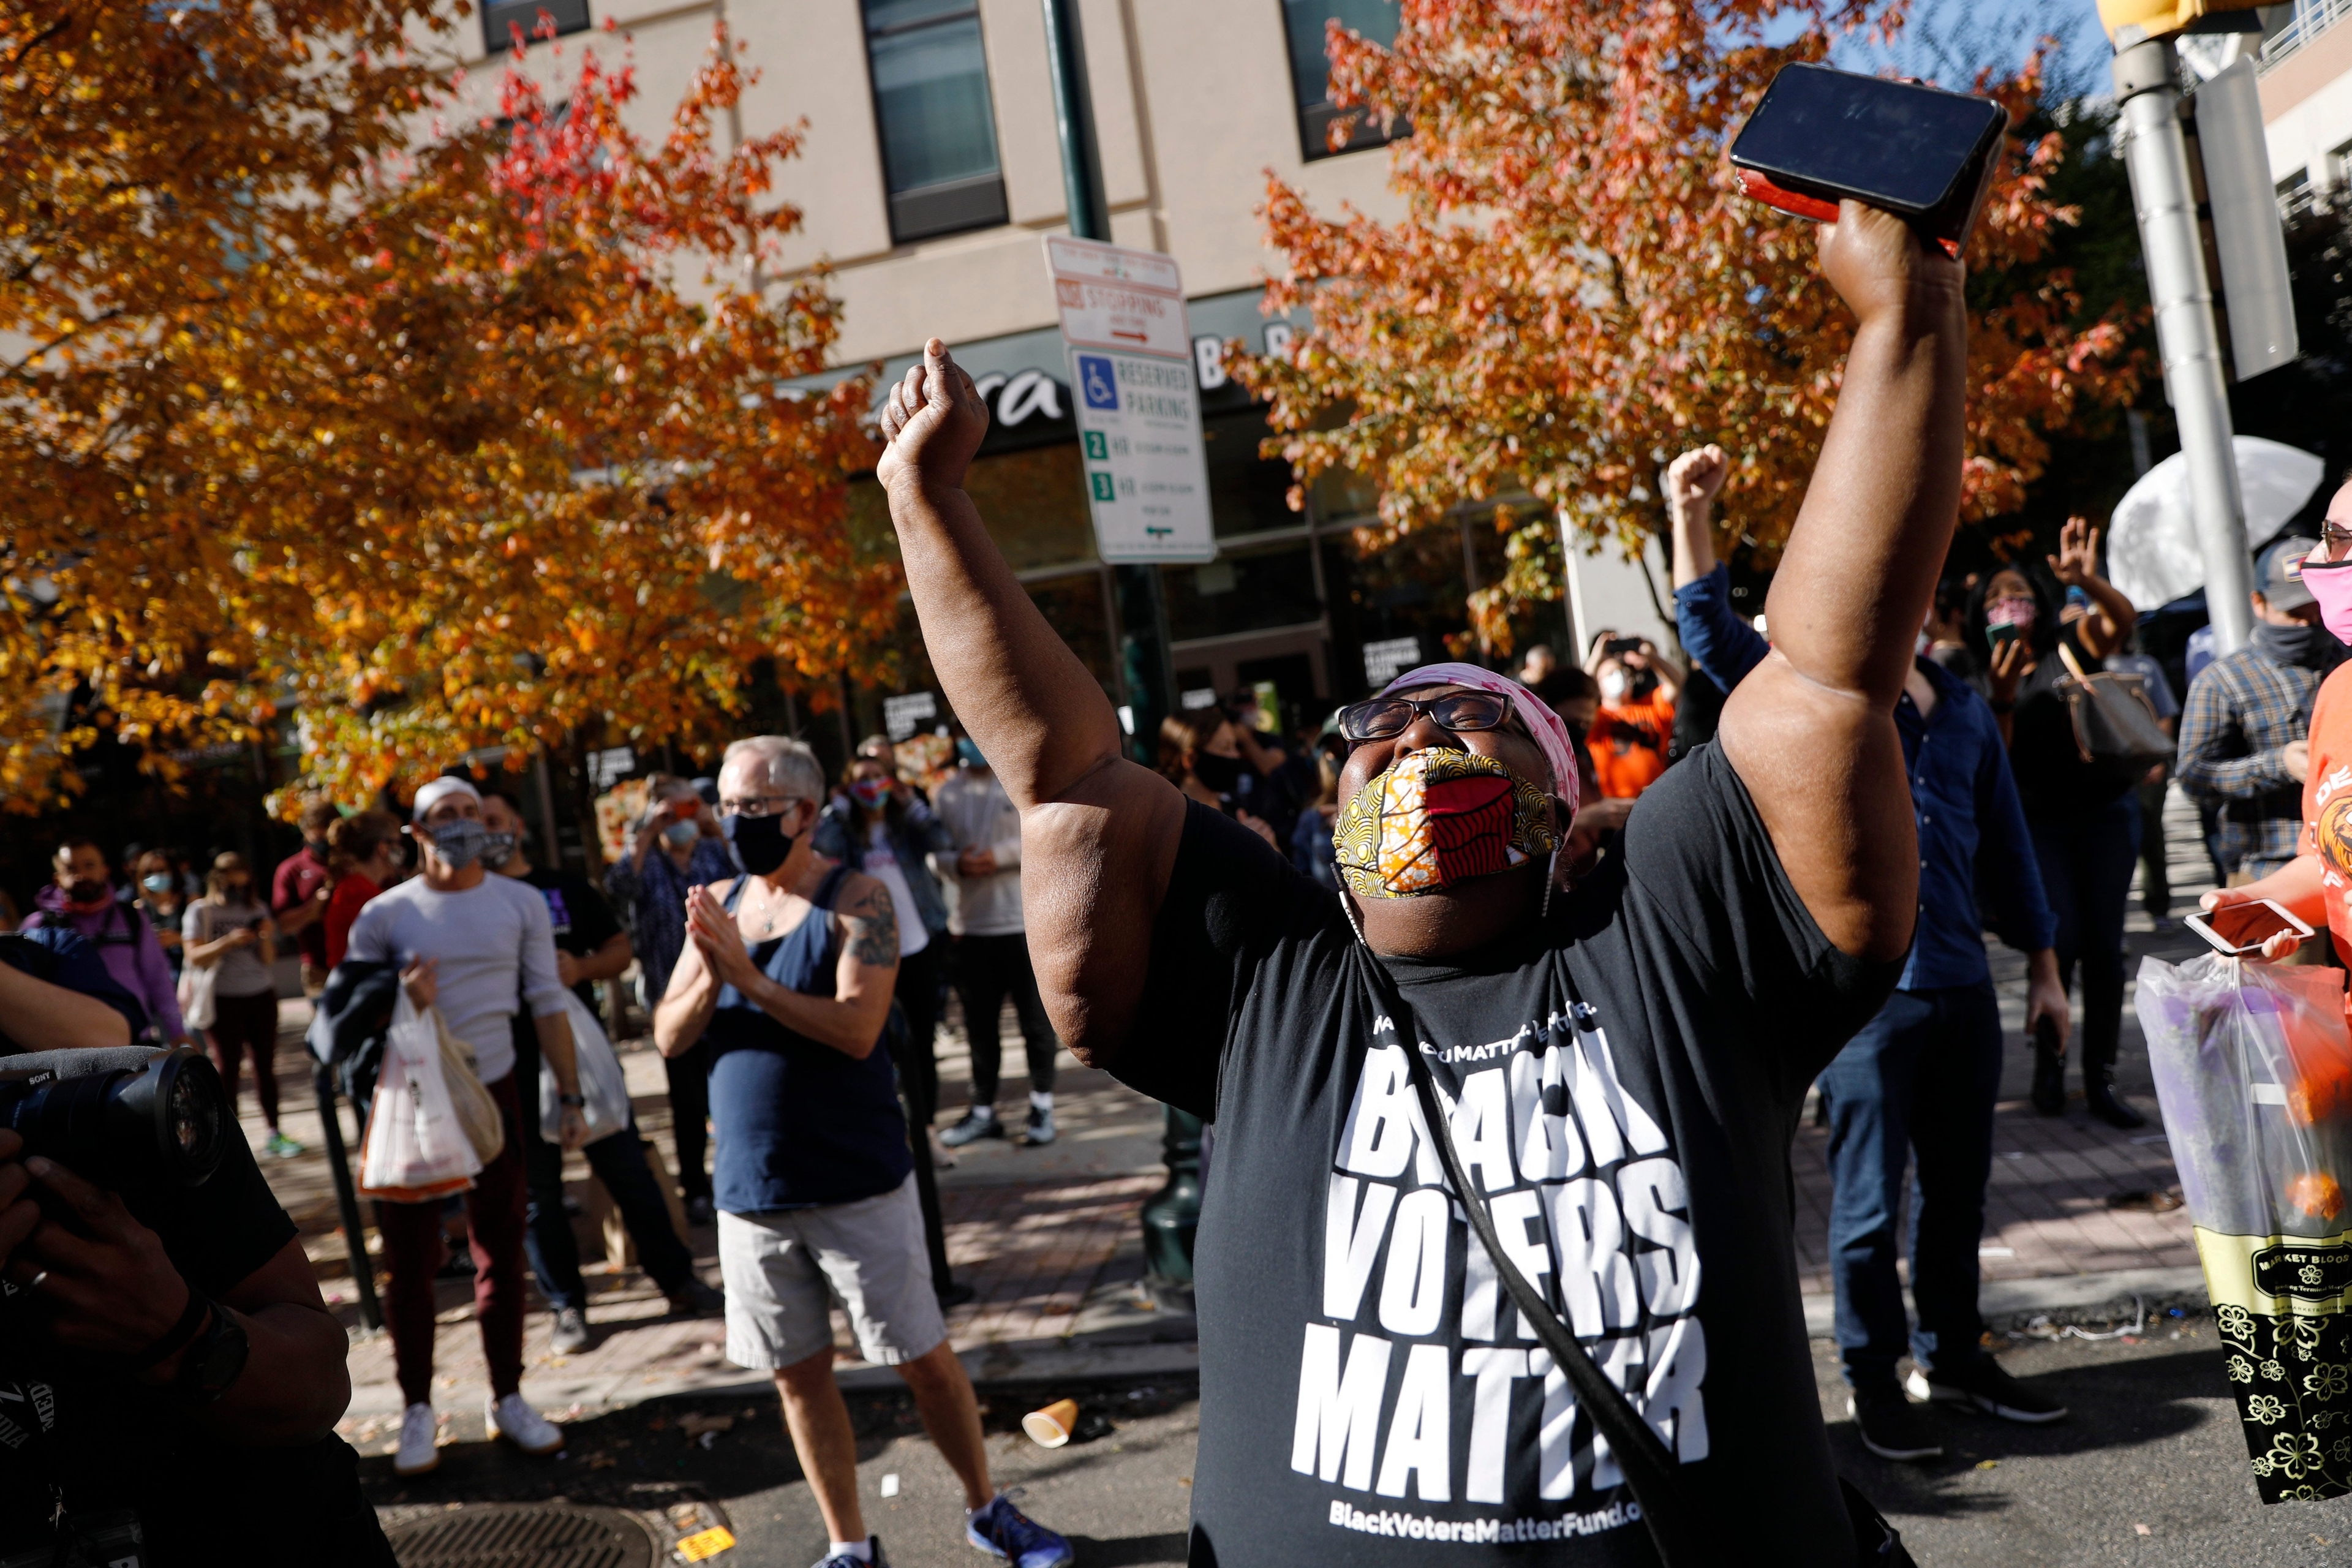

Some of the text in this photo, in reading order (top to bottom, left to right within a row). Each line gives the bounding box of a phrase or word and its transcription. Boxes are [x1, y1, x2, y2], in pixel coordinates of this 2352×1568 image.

[1087, 287, 1166, 319] STOPPING
[1117, 359, 1188, 391] RESERVED
[1126, 391, 1190, 421] PARKING
[1090, 433, 1103, 458] 2
[1097, 474, 1110, 499] 3
[1419, 1041, 1452, 1063] OU
[1453, 1023, 1531, 1063] MATT.
[29, 1071, 50, 1085] SONY
[2259, 1253, 2350, 1271] MARKET BLOOS
[1329, 1499, 1642, 1544] BlackVotersMatterFund.o
